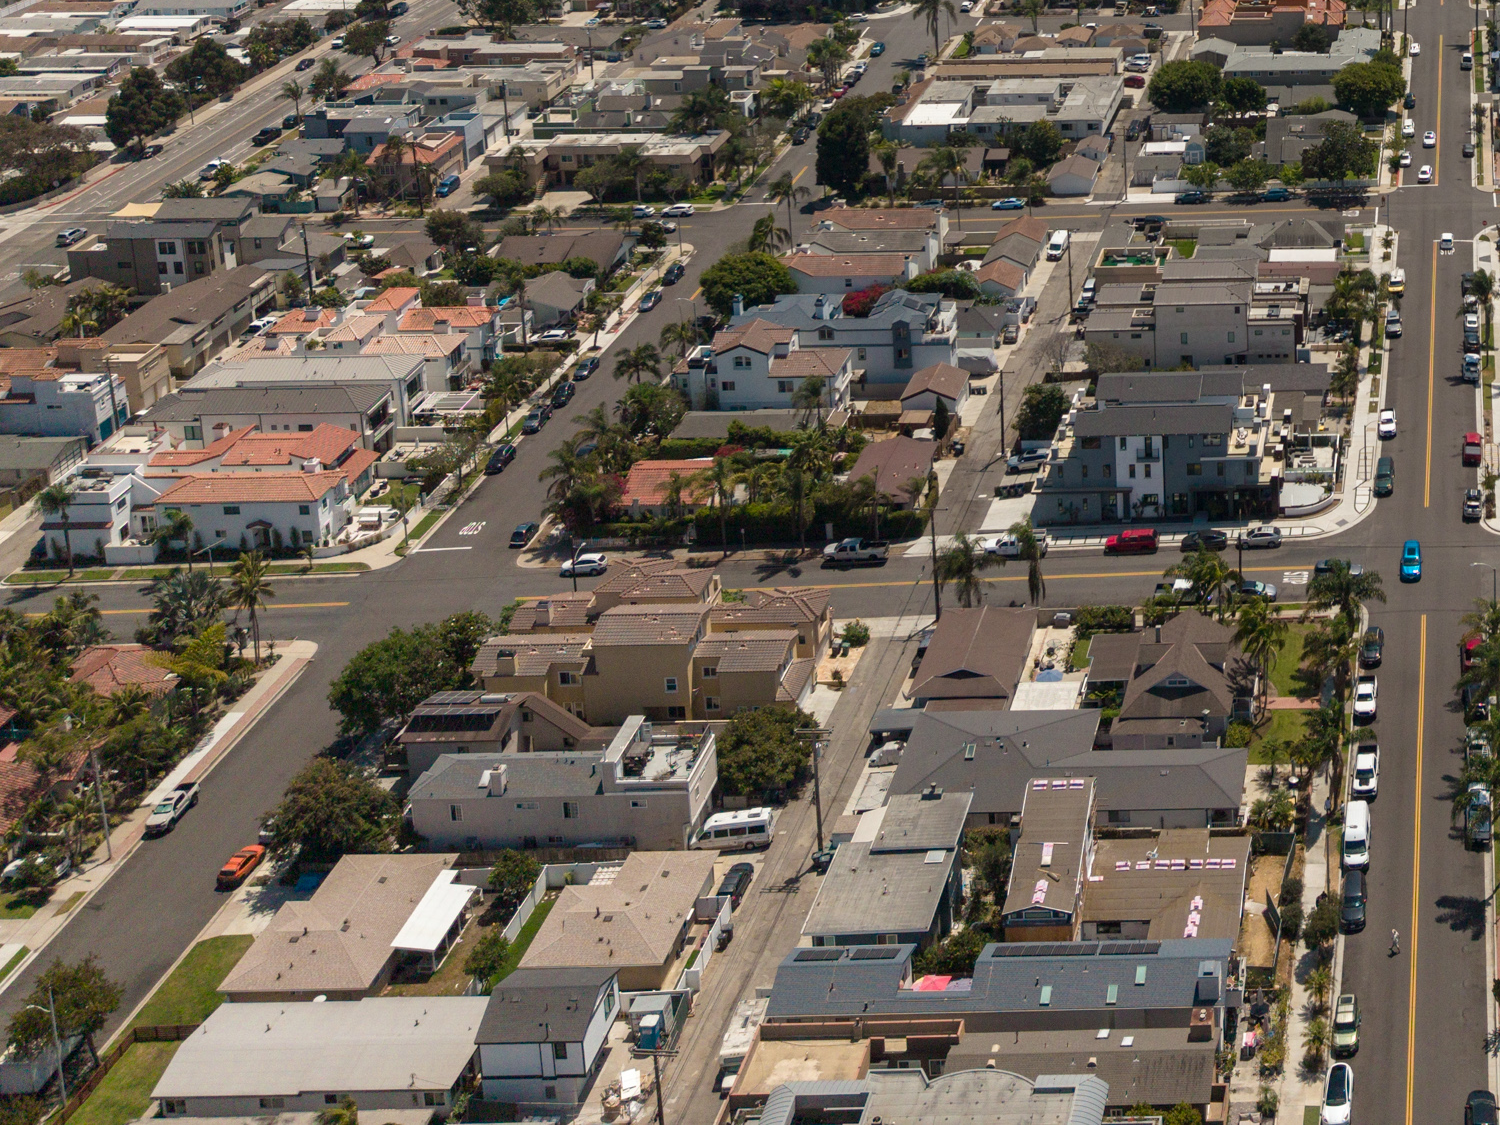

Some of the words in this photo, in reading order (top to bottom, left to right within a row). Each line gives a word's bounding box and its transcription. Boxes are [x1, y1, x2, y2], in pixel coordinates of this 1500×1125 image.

[1439, 247, 1456, 256] STOP
[458, 521, 487, 535] STOP
[1282, 571, 1309, 585] STOP
